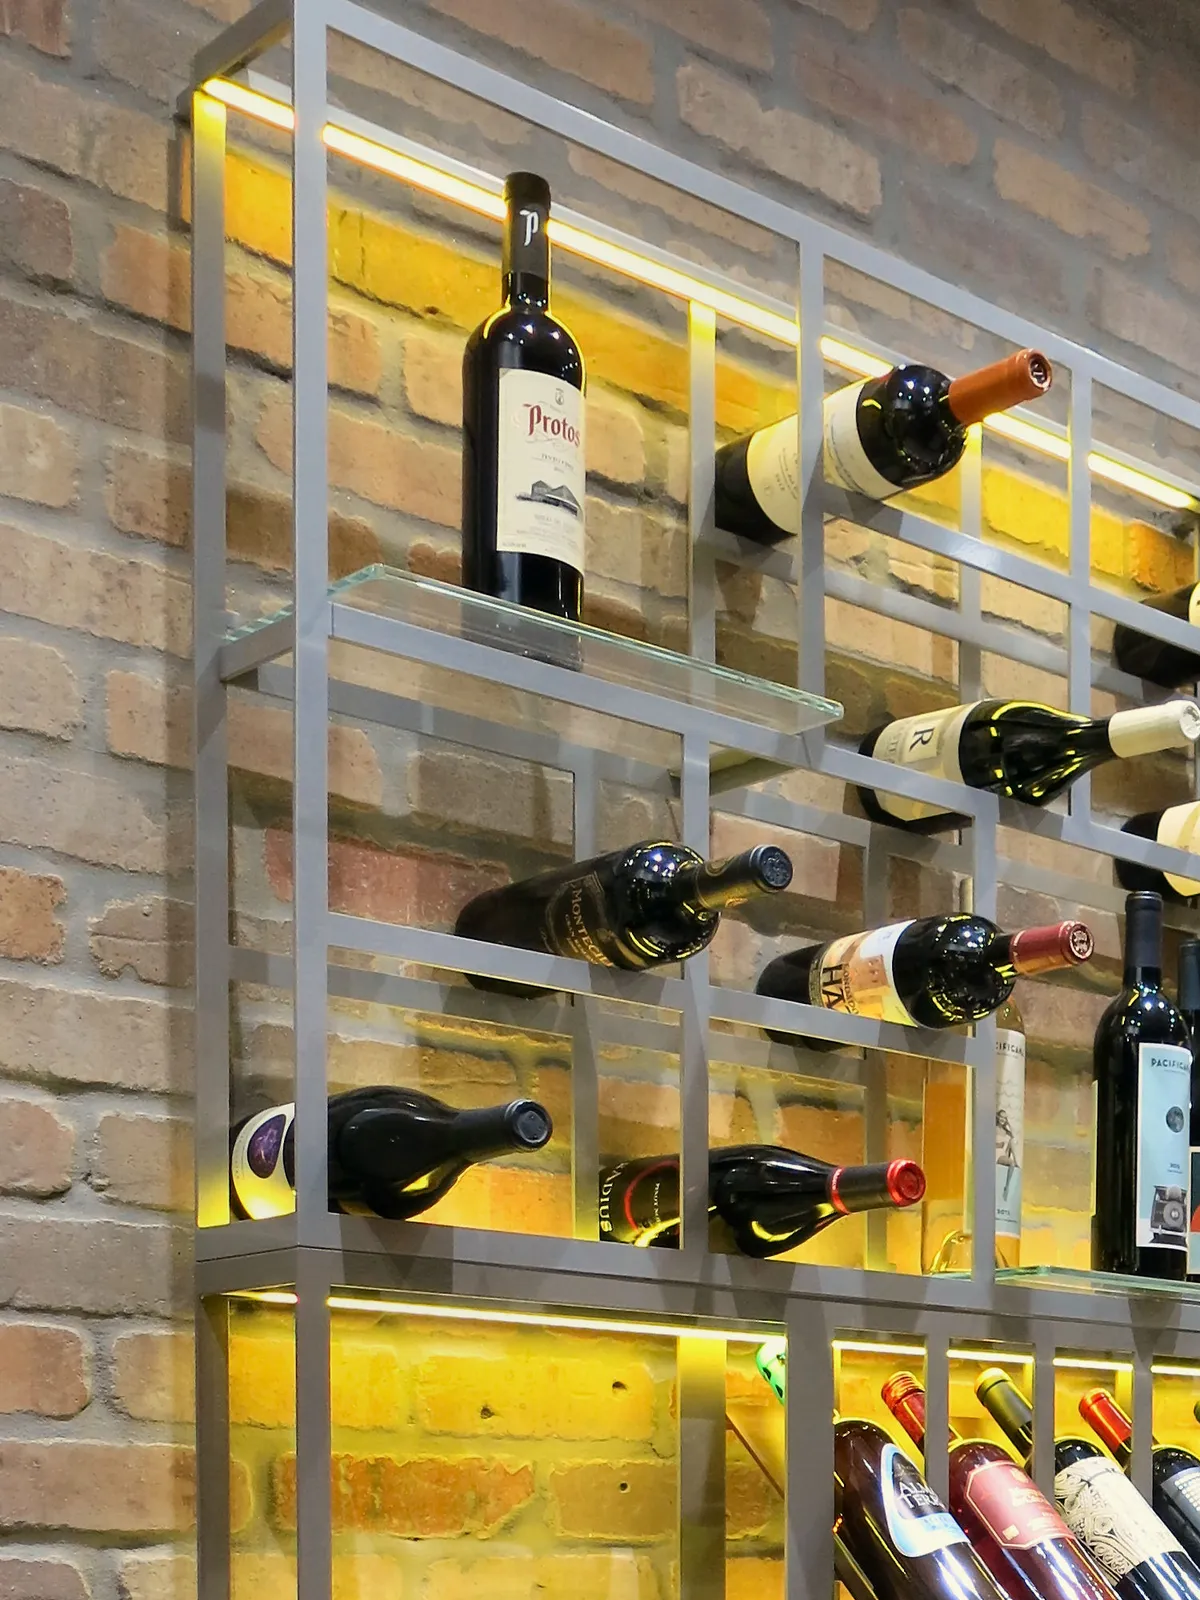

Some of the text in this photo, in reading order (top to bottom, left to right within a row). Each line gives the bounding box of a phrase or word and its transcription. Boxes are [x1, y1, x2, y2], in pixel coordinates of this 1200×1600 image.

[523, 403, 580, 448] Protos
[909, 727, 935, 752] R
[821, 963, 852, 1015] HA
